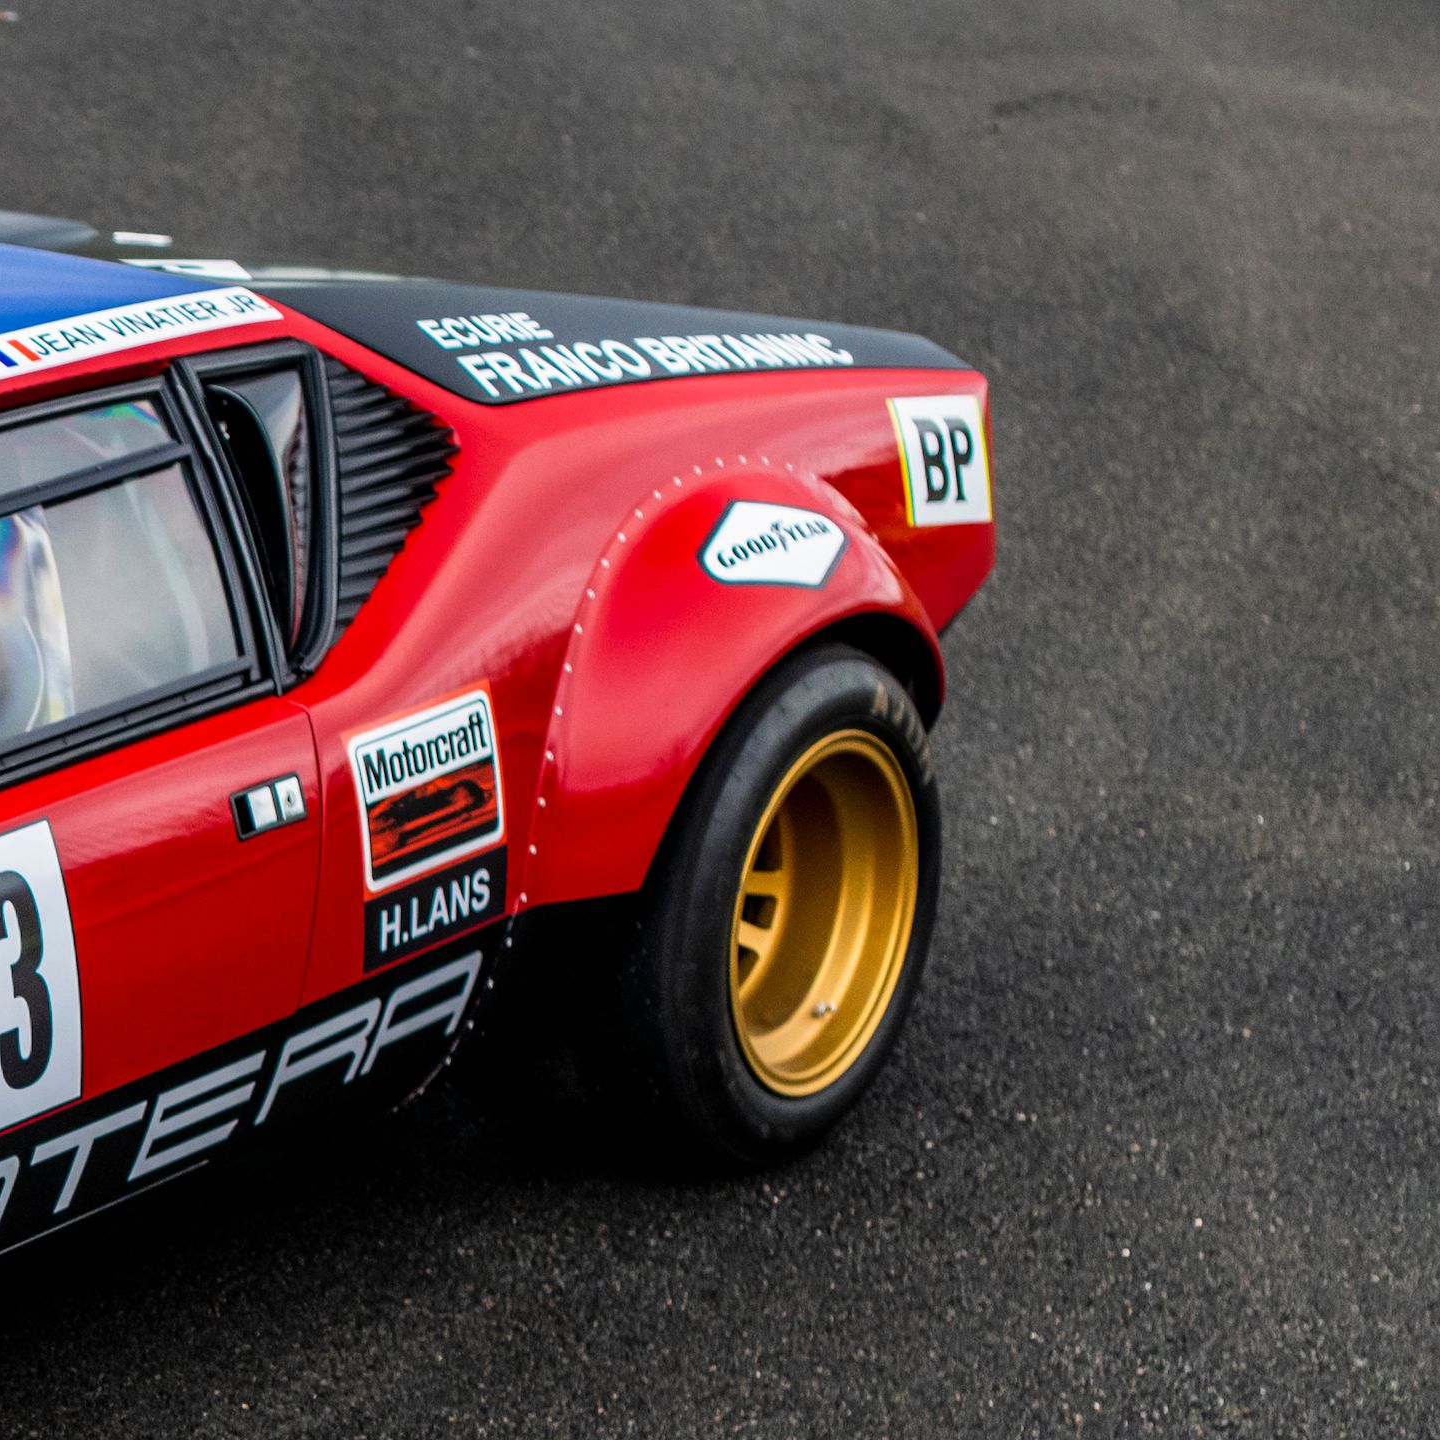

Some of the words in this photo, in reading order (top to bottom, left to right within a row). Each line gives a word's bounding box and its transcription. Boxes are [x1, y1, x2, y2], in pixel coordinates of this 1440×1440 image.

[29, 323, 106, 356] JEAN
[99, 299, 229, 338] VINATIER
[416, 312, 555, 350] ECURIE
[456, 339, 652, 398] FRANCO
[634, 333, 854, 374] BRITANNIC
[912, 418, 973, 503] BP
[362, 711, 488, 794] Motorcraft
[378, 868, 491, 952] H.LANS
